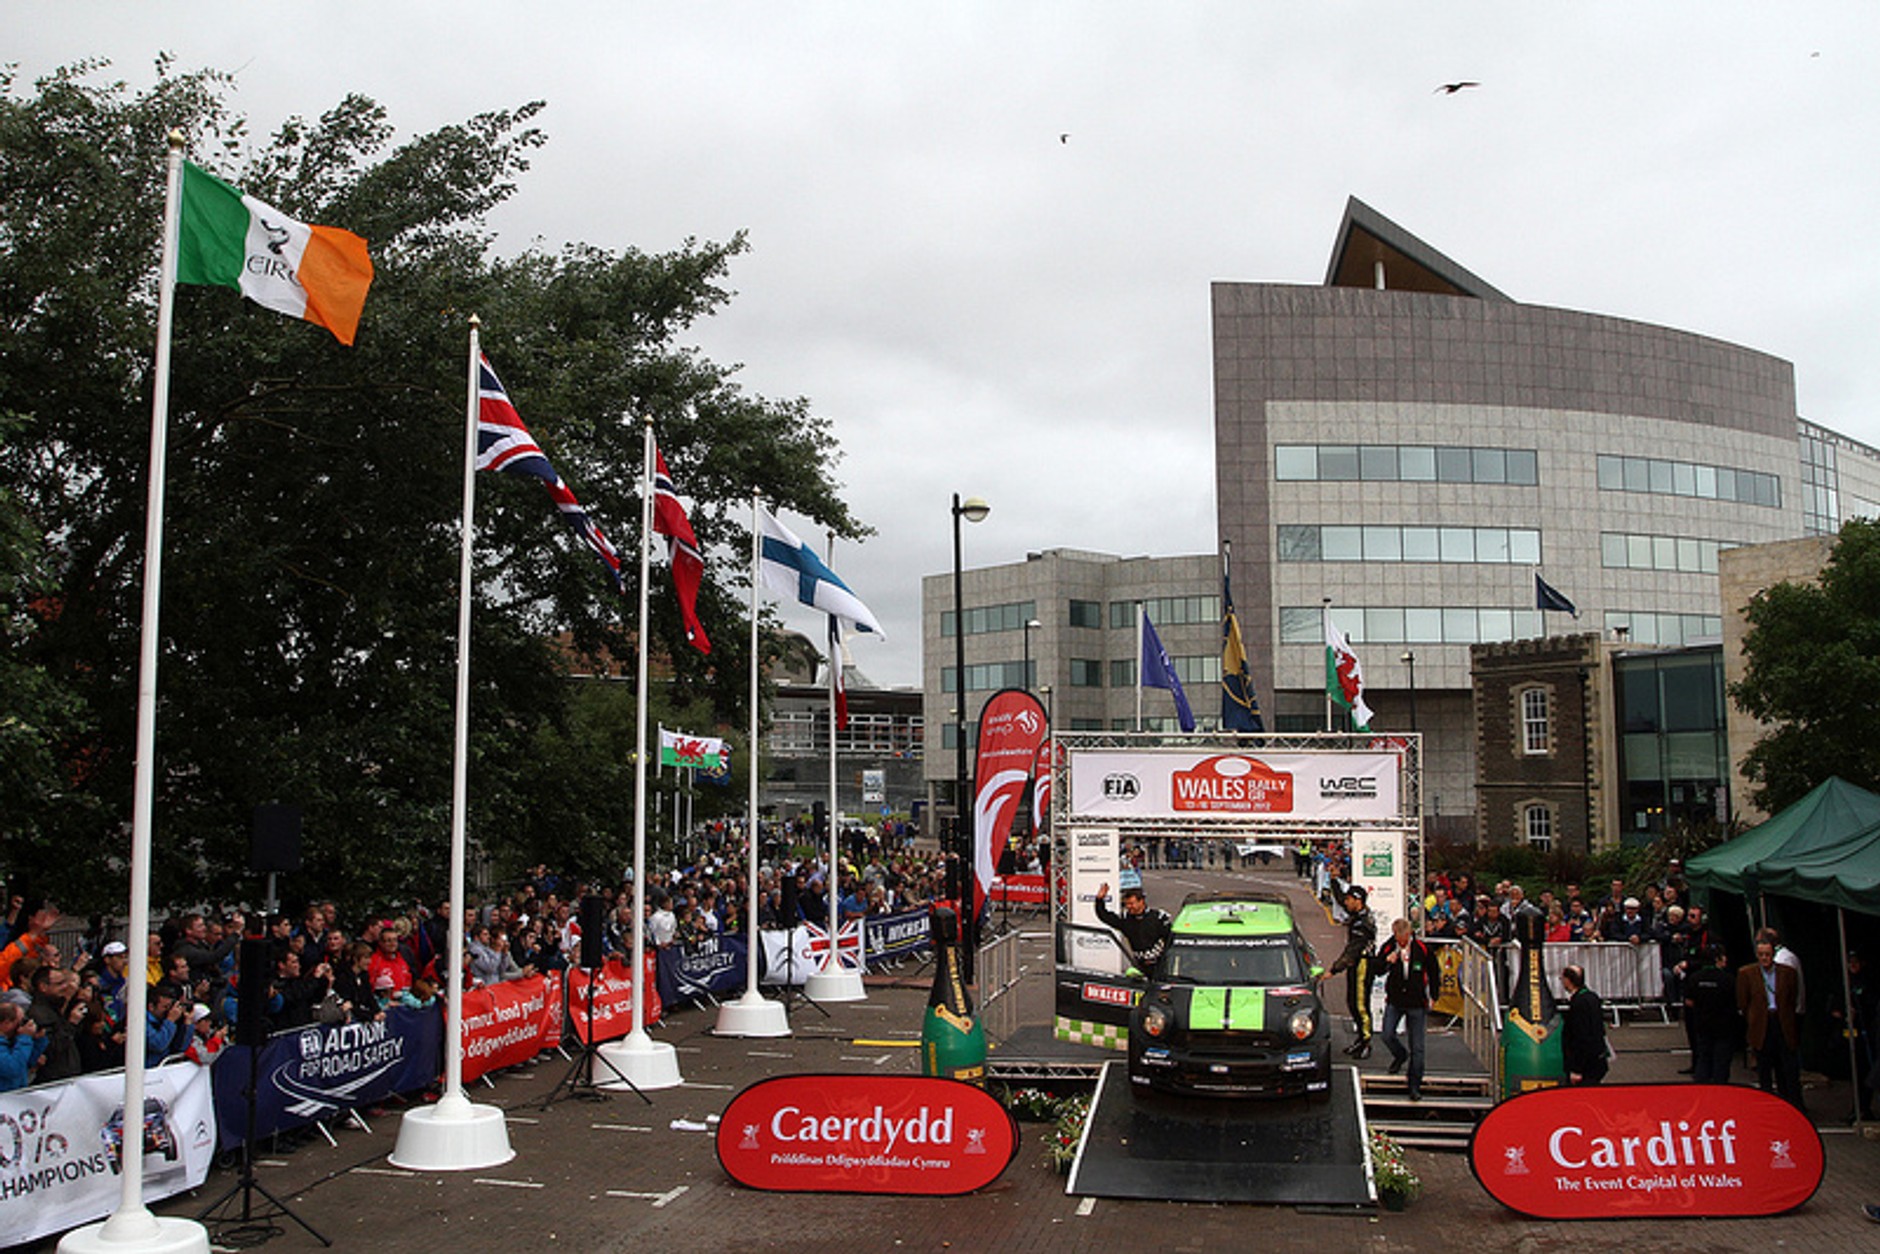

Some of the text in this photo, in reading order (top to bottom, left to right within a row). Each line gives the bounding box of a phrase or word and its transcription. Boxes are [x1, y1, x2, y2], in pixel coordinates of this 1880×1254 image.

[1104, 778, 1136, 794] FIA
[1177, 778, 1245, 800] WALES
[1248, 779, 1287, 790] RALLY
[1320, 777, 1376, 790] WRC
[324, 1021, 386, 1053] ACTION
[321, 1051, 361, 1078] ROAD
[363, 1037, 404, 1068] SAFETY
[771, 1106, 952, 1154] Caerdydd
[1549, 1120, 1736, 1168] Cardiff
[912, 1156, 950, 1170] Cymru
[0, 1153, 106, 1200] HAMPIONS
[1555, 1174, 1742, 1193] The Event Capital of Wales
